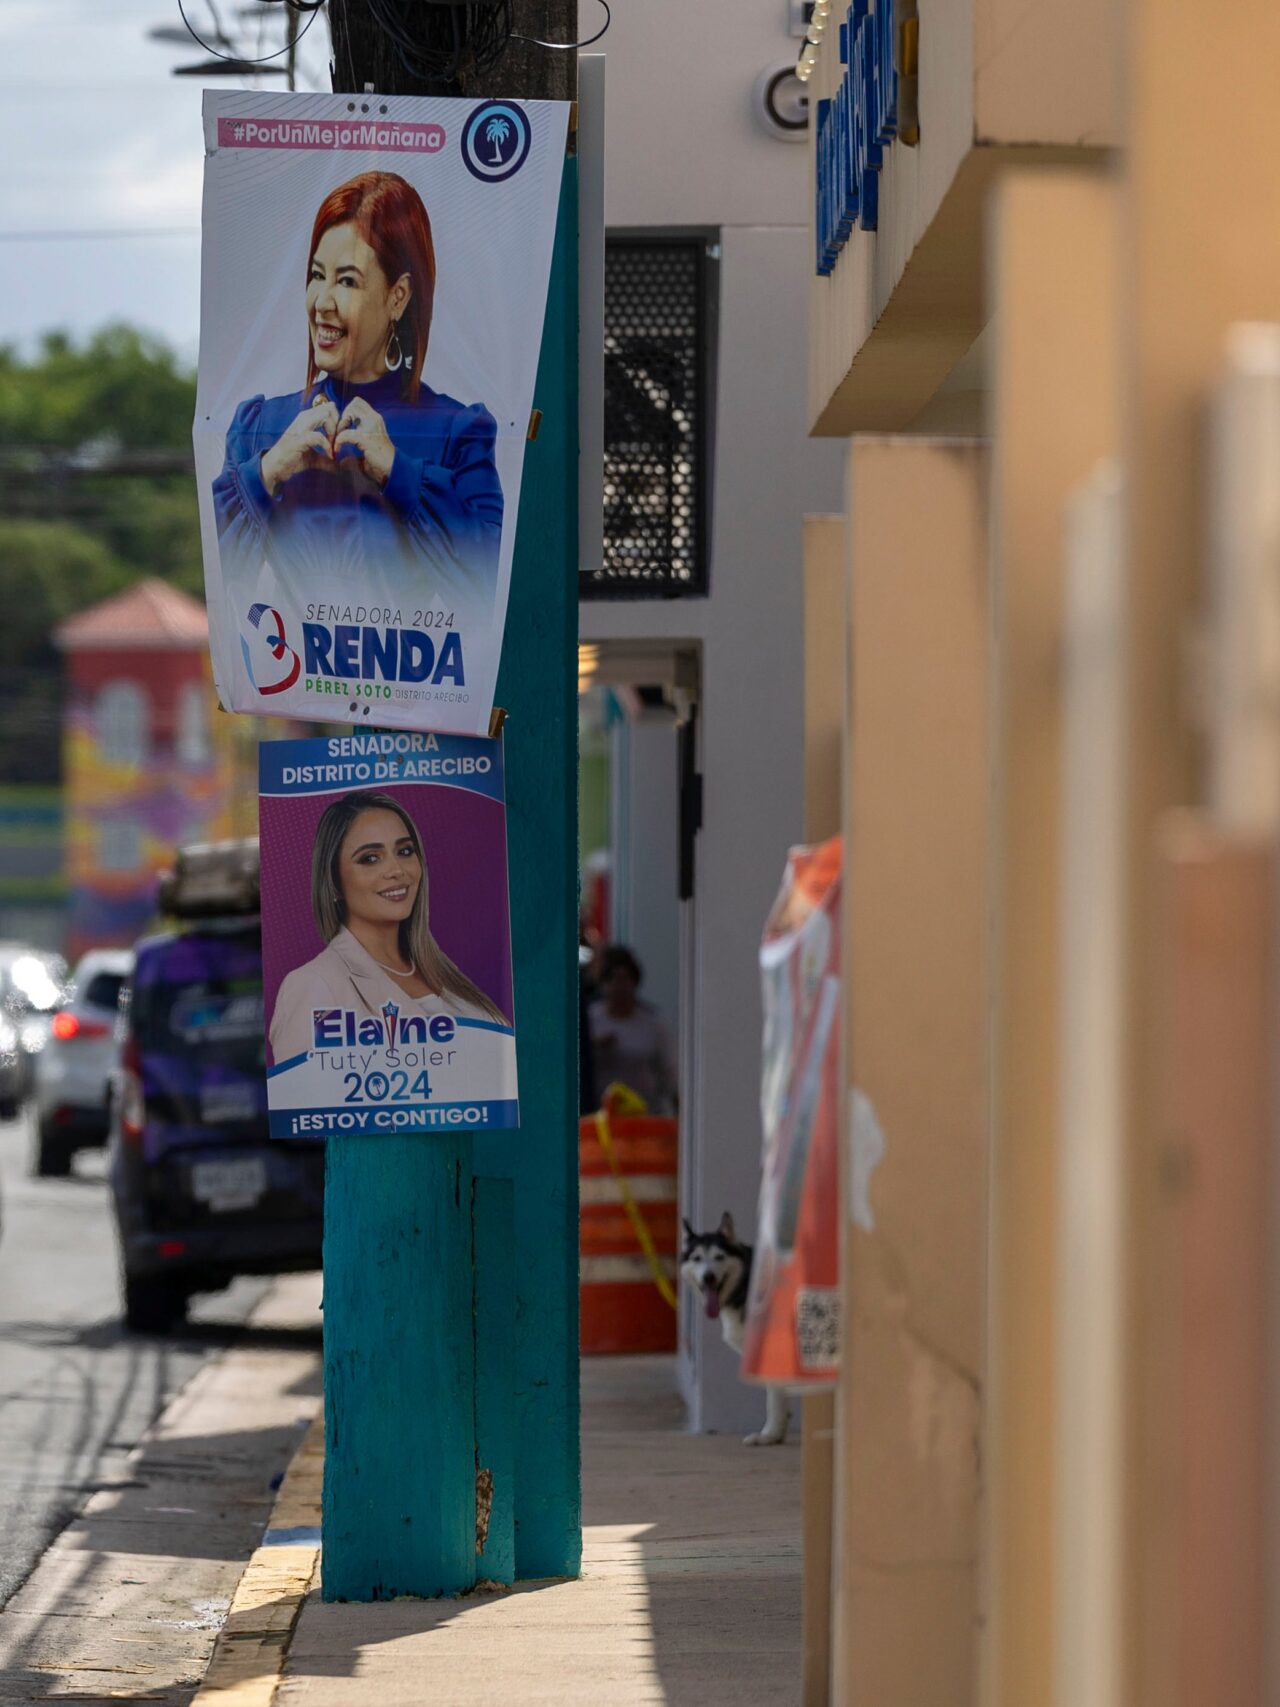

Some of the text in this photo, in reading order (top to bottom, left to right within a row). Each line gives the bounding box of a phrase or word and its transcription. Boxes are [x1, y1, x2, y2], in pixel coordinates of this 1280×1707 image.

[234, 123, 441, 148] #PorUnMejorMañana
[306, 603, 455, 630] SENADORA 2024
[305, 676, 470, 704] PÉREZ SOTO DISTRITO ARECIBO
[328, 733, 439, 758] SENADORA
[282, 756, 492, 785] DISTRITO DE ARECIBO
[313, 1002, 455, 1050] Elaine
[385, 1048, 457, 1069] Soler
[343, 1070, 433, 1103] 2024
[292, 1106, 489, 1134] ¡ESTOY CONTIGO!
